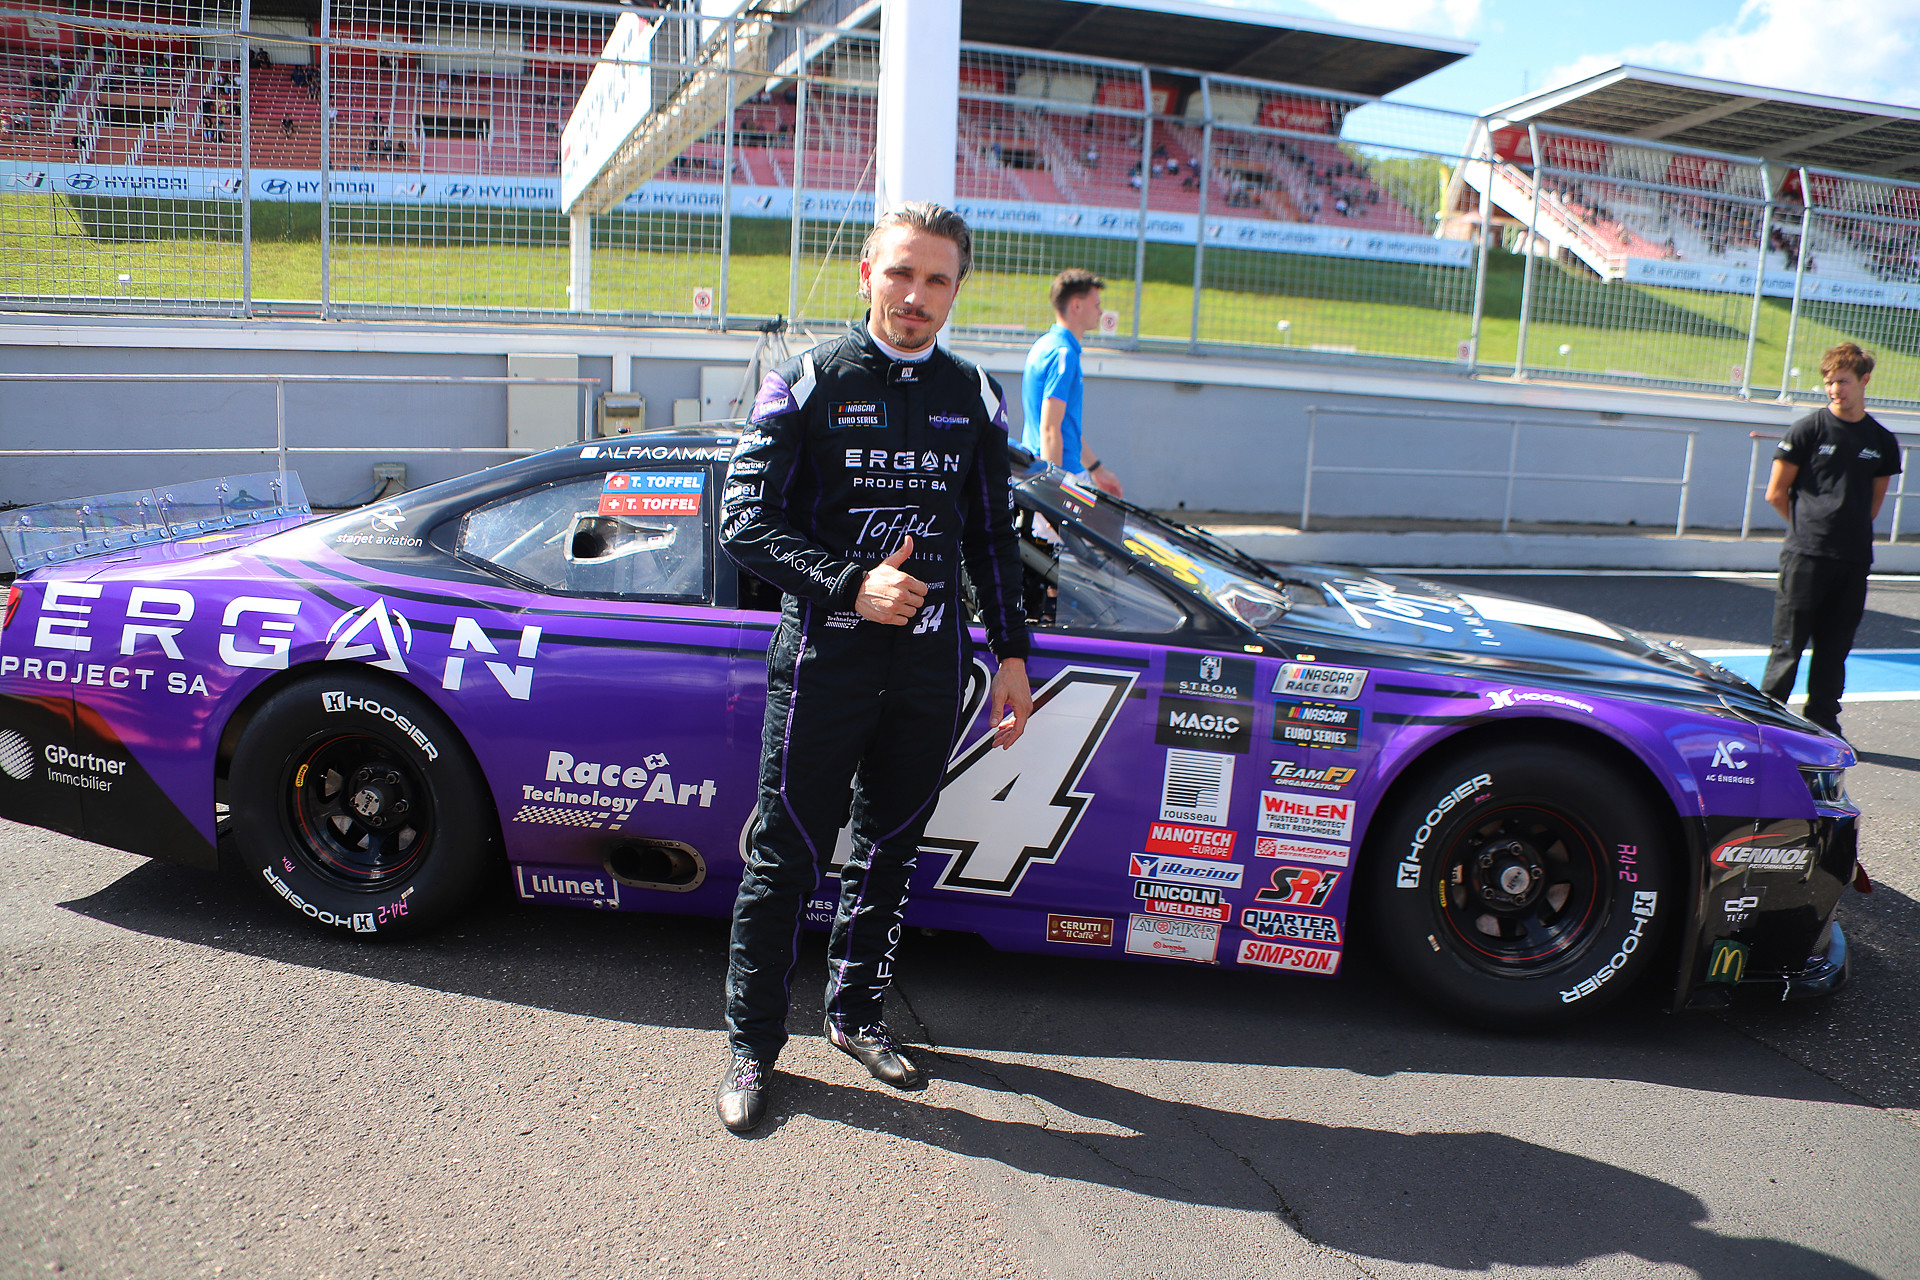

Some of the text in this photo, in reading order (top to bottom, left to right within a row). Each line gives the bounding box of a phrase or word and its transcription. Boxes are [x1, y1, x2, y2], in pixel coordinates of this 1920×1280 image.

[104, 176, 187, 190] HYUNDAI
[479, 186, 554, 199] HYUNDAI
[847, 404, 876, 413] NASCAR
[838, 416, 878, 425] EURO SERIES
[929, 414, 970, 425] HOOSIER
[630, 476, 701, 488] T. TOFFEL
[853, 477, 947, 491] PROJECT SA
[625, 498, 697, 510] T. TOFFEL
[335, 532, 423, 547] starjet aviation
[845, 549, 943, 562] IMMOLIER
[912, 602, 946, 635] 34
[1, 655, 209, 697] PROJECT SA
[1305, 668, 1355, 683] NASCAR
[1179, 681, 1238, 695] STROM
[1285, 681, 1349, 695] RACE CAR
[1513, 692, 1595, 714] HOOSIER
[1302, 707, 1349, 724] NASCAR
[346, 695, 439, 762] HOOSIER
[1284, 726, 1348, 745] EURO SERIES
[44, 744, 126, 776] GPartner
[47, 767, 112, 792] Immobilier
[1274, 778, 1342, 791] ORGANIZATION
[1705, 774, 1717, 782] AC
[522, 784, 639, 813] Technology
[1163, 808, 1218, 823] rousseau
[1264, 795, 1348, 820] WHELEN
[1265, 813, 1346, 829] TRUSTED TO PROTECT
[1406, 773, 1494, 863] HOOSIER
[1151, 825, 1233, 847] NANOTECH
[1269, 822, 1342, 837] FIRST RESPONDERS
[1278, 844, 1347, 858] SAMSONAS
[1716, 846, 1810, 865] KENNOL
[1159, 862, 1242, 882] iRacing
[262, 865, 351, 929] HOOSIER
[1139, 883, 1217, 905] LINCOLN
[1154, 901, 1222, 919] WELDERS
[1060, 920, 1101, 932] CERUTTI
[1244, 910, 1334, 930] QUARTER
[1257, 923, 1337, 942] MASTER
[1243, 943, 1330, 970] SIMPSON
[1559, 916, 1649, 1003] HOOSIER
